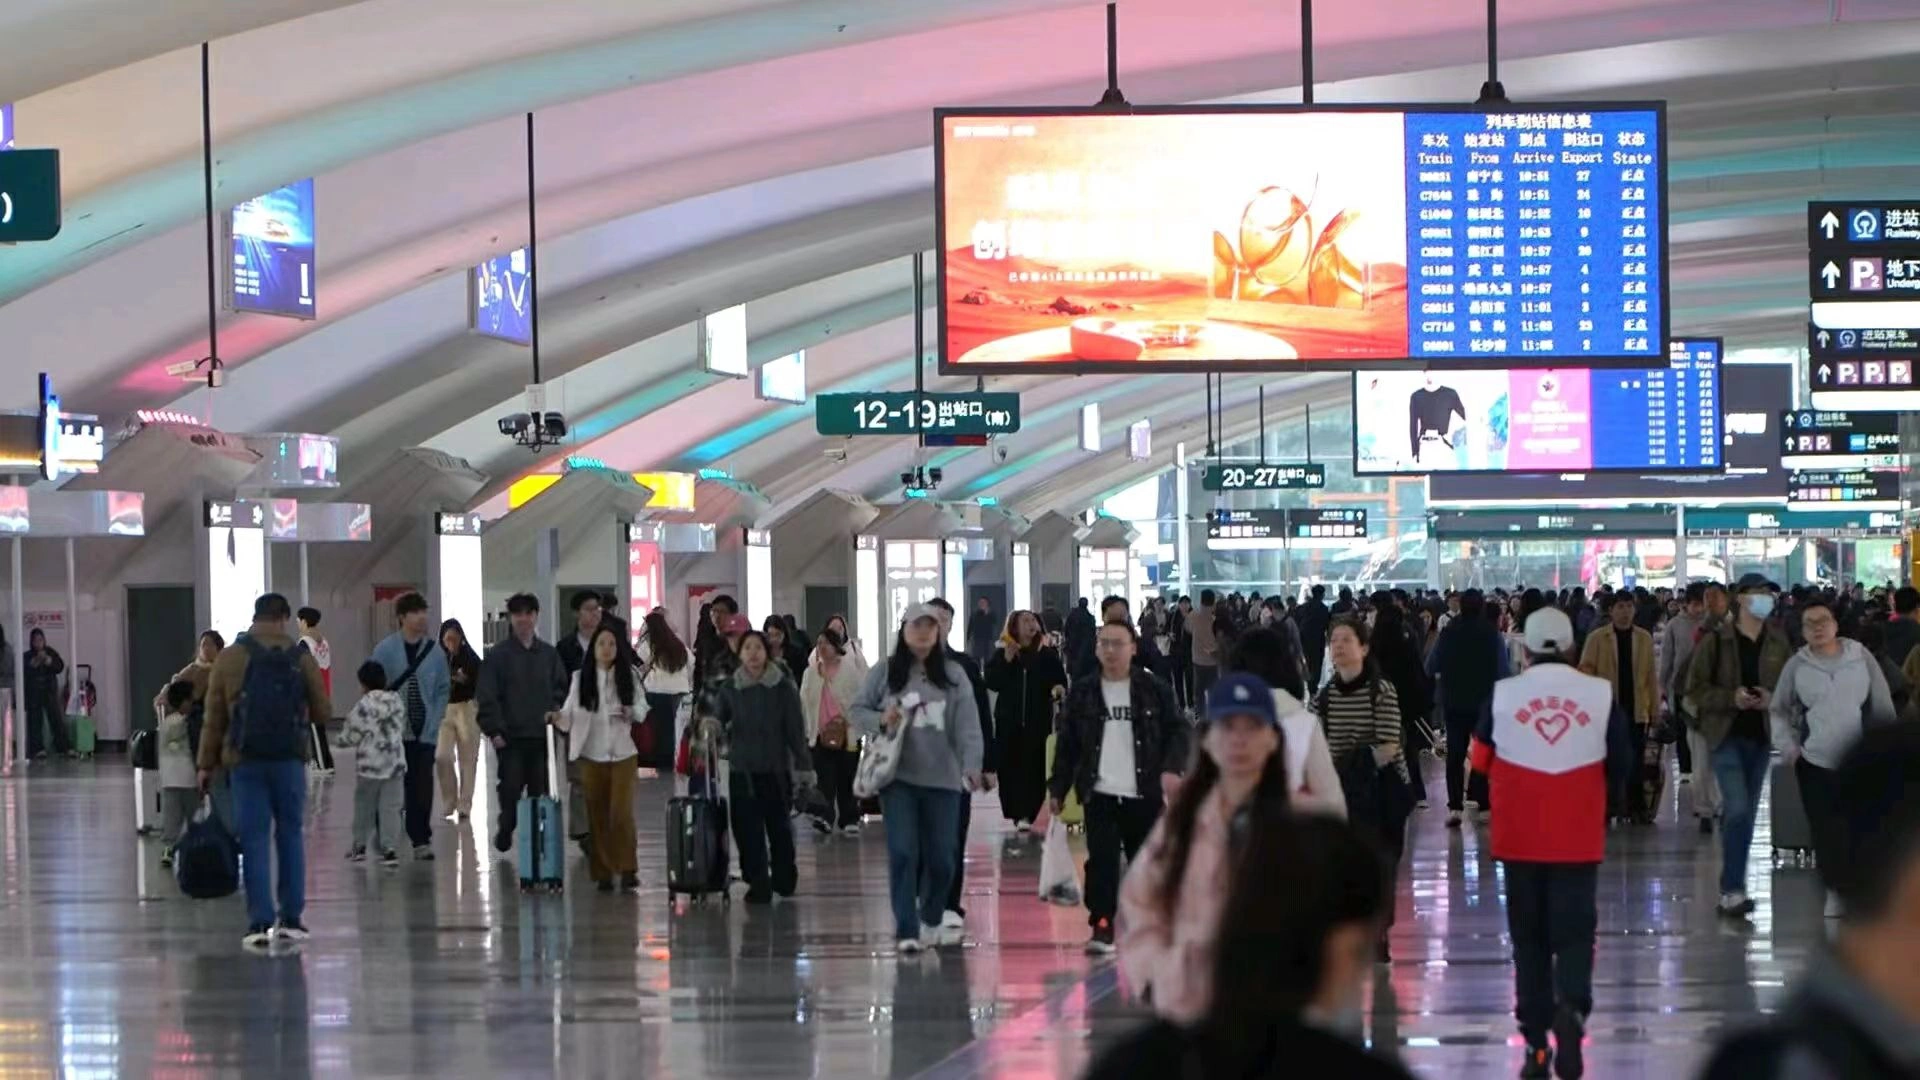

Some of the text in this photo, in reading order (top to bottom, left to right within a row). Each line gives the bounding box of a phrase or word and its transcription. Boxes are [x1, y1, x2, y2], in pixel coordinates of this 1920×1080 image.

[1486, 113, 1591, 129] 列车到站信息表
[1422, 133, 1448, 147] 车次
[1464, 133, 1504, 147] 始发站
[1563, 132, 1603, 146] 到达口
[1618, 132, 1645, 146] 状态
[1418, 152, 1651, 164] Train From Arrive Export State
[1885, 208, 1920, 228] 进站
[1853, 261, 1880, 289] P2
[1886, 259, 1920, 277] 地下
[853, 400, 937, 429] 12-19
[939, 400, 982, 417] 出站口
[1222, 468, 1277, 487] 20-27
